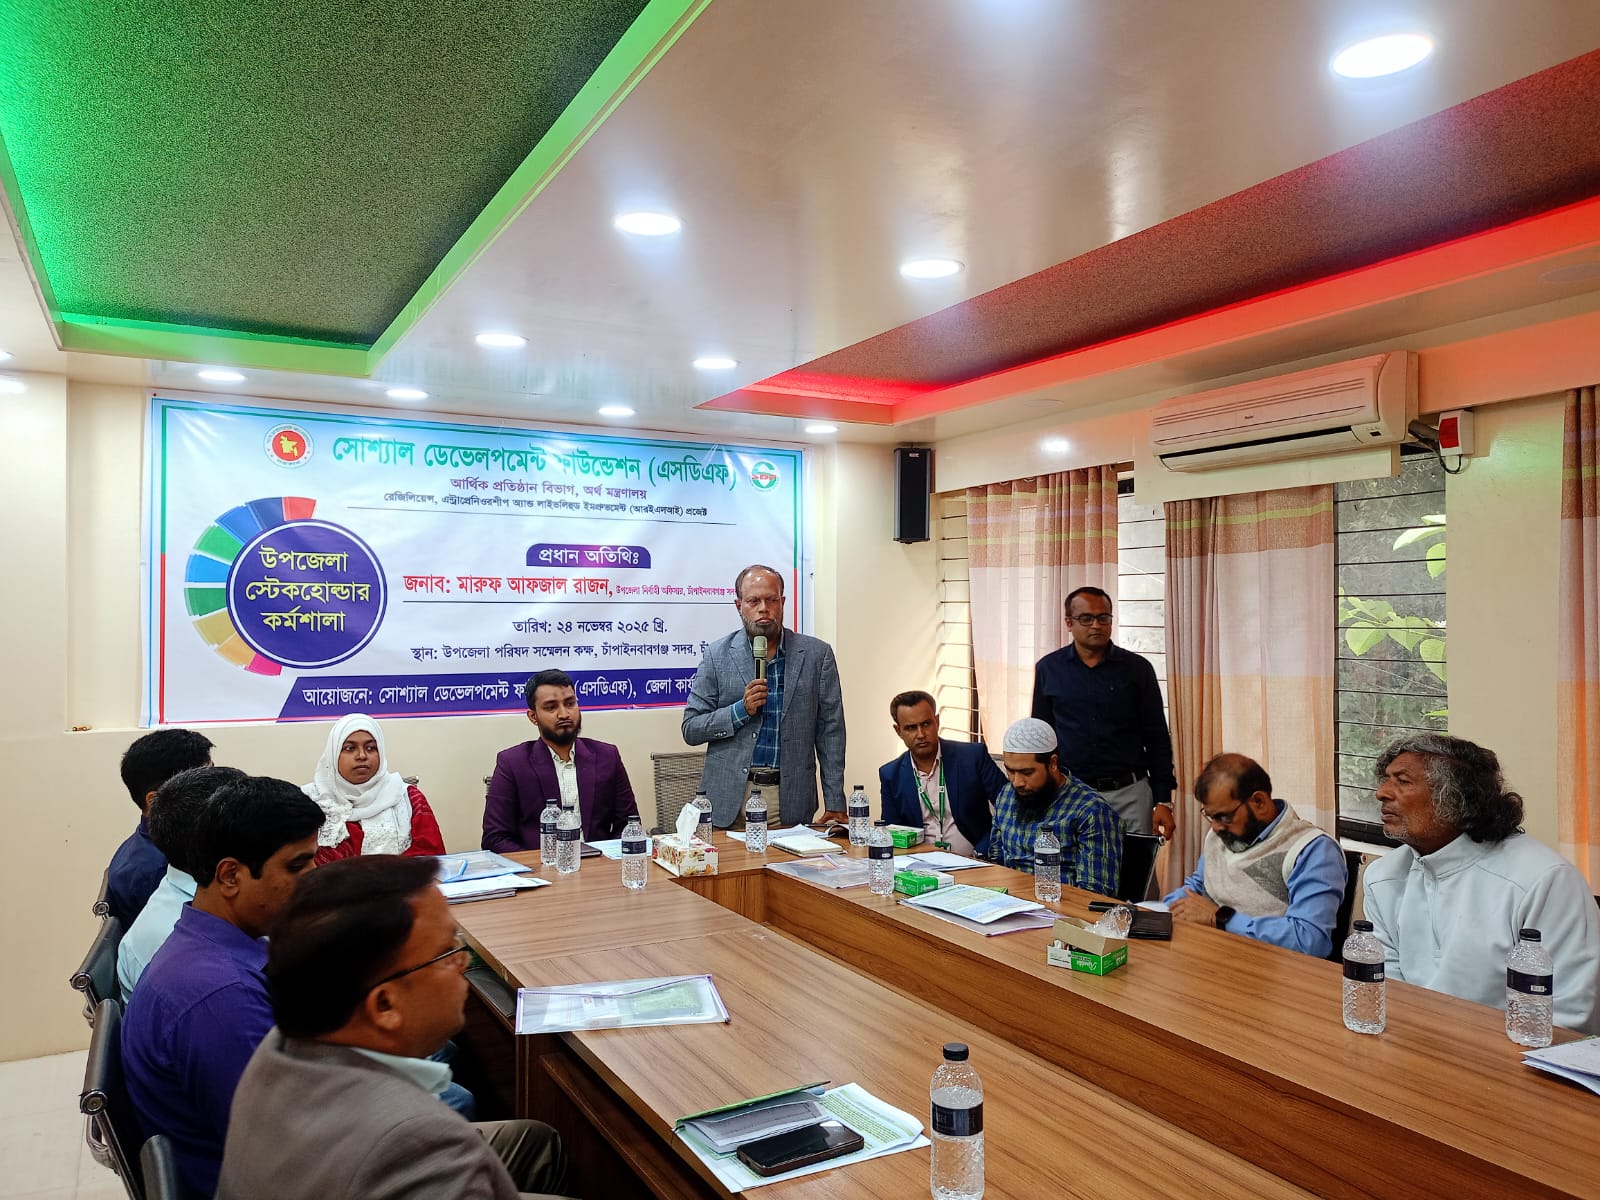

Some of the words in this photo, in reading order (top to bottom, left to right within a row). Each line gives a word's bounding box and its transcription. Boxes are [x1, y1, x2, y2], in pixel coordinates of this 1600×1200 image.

[333, 436, 415, 465] সোশ্যাল
[424, 442, 546, 472] ডেভেলপমেন্ট
[649, 455, 736, 491] (এসডিএফ)
[450, 477, 488, 491] আর্থিক
[493, 478, 537, 493] প্রতিষ্ঠান
[543, 481, 579, 497] বিভাগ,
[584, 484, 602, 496] অর্থ
[605, 487, 647, 500] মন্ত্রণালয়
[258, 544, 349, 572] উপজেলা
[538, 547, 579, 564] প্রধান
[245, 575, 372, 604] স্টেকহোল্ডার
[456, 574, 502, 595] মারুফ
[506, 575, 568, 595] আফজাল
[573, 576, 613, 598] রাজন,
[260, 605, 347, 632] কর্মশালা
[512, 617, 552, 634] তারিখ:
[557, 620, 573, 634] ২৪
[577, 621, 613, 633] নভেম্বর
[617, 620, 649, 633] ২০২৫
[410, 646, 438, 662] স্থান:
[442, 644, 490, 658] উপজেলা
[494, 643, 530, 658] পরিষদ
[533, 646, 570, 658] সম্মেলন
[574, 645, 598, 658] কক্ষ,
[601, 642, 669, 657] চাঁপাইনবাবগঞ্জ
[672, 644, 697, 657] সদর,
[379, 684, 429, 703] সোশ্যাল
[433, 679, 509, 702] ডেভেলপমেন্ট
[574, 676, 637, 700] (এসডিএফ),
[646, 677, 672, 694] জেলা
